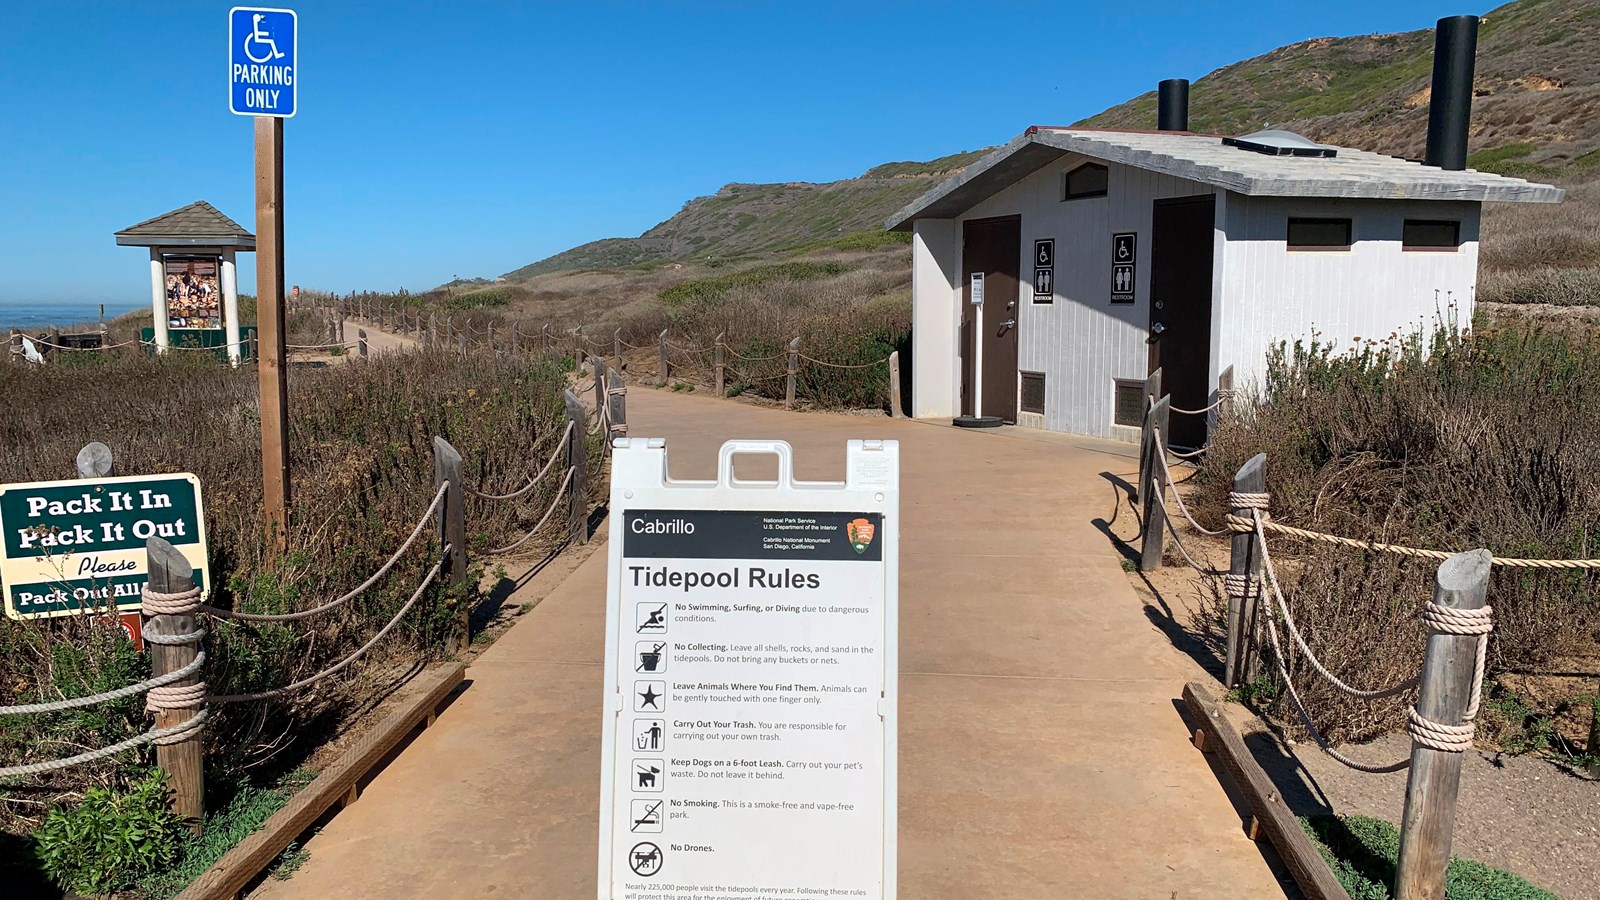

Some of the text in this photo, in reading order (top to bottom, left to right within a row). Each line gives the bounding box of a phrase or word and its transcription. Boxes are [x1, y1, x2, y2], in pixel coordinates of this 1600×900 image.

[233, 64, 292, 86] PARKING
[246, 88, 280, 109] ONLY
[26, 489, 172, 517] Pack It In
[632, 518, 695, 534] Cabrillo
[18, 518, 186, 548] Pack It Out
[774, 543, 791, 551] Diego,
[78, 556, 137, 576] Please
[629, 566, 820, 592] Tidepool Rules
[19, 589, 68, 605] Pack
[73, 586, 108, 600] Out
[114, 583, 140, 597] All
[675, 603, 687, 611] No
[689, 603, 732, 613] Swimming,
[733, 603, 763, 613] Surfing,
[776, 604, 800, 614] Diving
[802, 605, 816, 613] due
[829, 605, 869, 615] dangerous
[674, 614, 716, 623] conditions.
[674, 643, 686, 651] No
[687, 643, 728, 653] Collecting.
[731, 644, 752, 652] Leave
[754, 644, 763, 652] all
[765, 644, 788, 653] shells,
[791, 644, 813, 653] rocks,
[815, 645, 829, 653] and
[861, 646, 873, 654] the
[674, 654, 712, 664] tidepools.
[714, 654, 725, 663] Do
[742, 655, 762, 665] bring
[763, 657, 778, 665] any
[779, 655, 809, 664] buckets
[821, 657, 839, 665] nets.
[673, 682, 696, 690] Leave
[697, 682, 729, 691] Animals
[731, 682, 757, 691] Where
[759, 683, 774, 691] You
[775, 683, 792, 692] Find
[794, 684, 819, 692] Them.
[821, 684, 851, 693] Animals
[673, 693, 683, 702] be
[684, 693, 708, 703] gently
[710, 694, 742, 703] touched
[743, 694, 761, 703] with
[779, 695, 802, 705] finger
[804, 695, 822, 705] only.
[673, 719, 695, 729] Carry
[696, 720, 711, 728] Out
[713, 720, 731, 729] Your
[733, 720, 756, 729] Trash.
[758, 721, 772, 729] You
[789, 722, 833, 731] responsible
[835, 722, 846, 730] for
[673, 731, 705, 742] carrying
[706, 732, 719, 740] out
[721, 733, 739, 741] your
[760, 733, 781, 741] trash.
[671, 758, 691, 768] Keep
[693, 758, 712, 768] Dogs
[733, 759, 757, 767] 6-foot
[759, 759, 784, 768] Leash.
[786, 760, 807, 770] Carry
[809, 761, 822, 769] out
[824, 762, 842, 770] your
[844, 761, 863, 770] pet’s
[671, 770, 785, 780] waste. Do not leave it behind.
[670, 799, 682, 807] No
[684, 799, 720, 809] Smoking.
[722, 799, 738, 808] This
[740, 800, 746, 808] is
[755, 800, 798, 809] smoke-free
[800, 801, 815, 810] and
[817, 802, 854, 812] vape-free
[670, 810, 690, 820] park.
[671, 843, 715, 852] No Drones.
[625, 883, 647, 891] Nearly
[648, 883, 675, 892] 225,000
[676, 884, 699, 893] people
[715, 885, 727, 893] the
[728, 885, 759, 894] tidepools
[760, 887, 779, 895] every
[797, 887, 829, 896] Following
[830, 888, 848, 896] these
